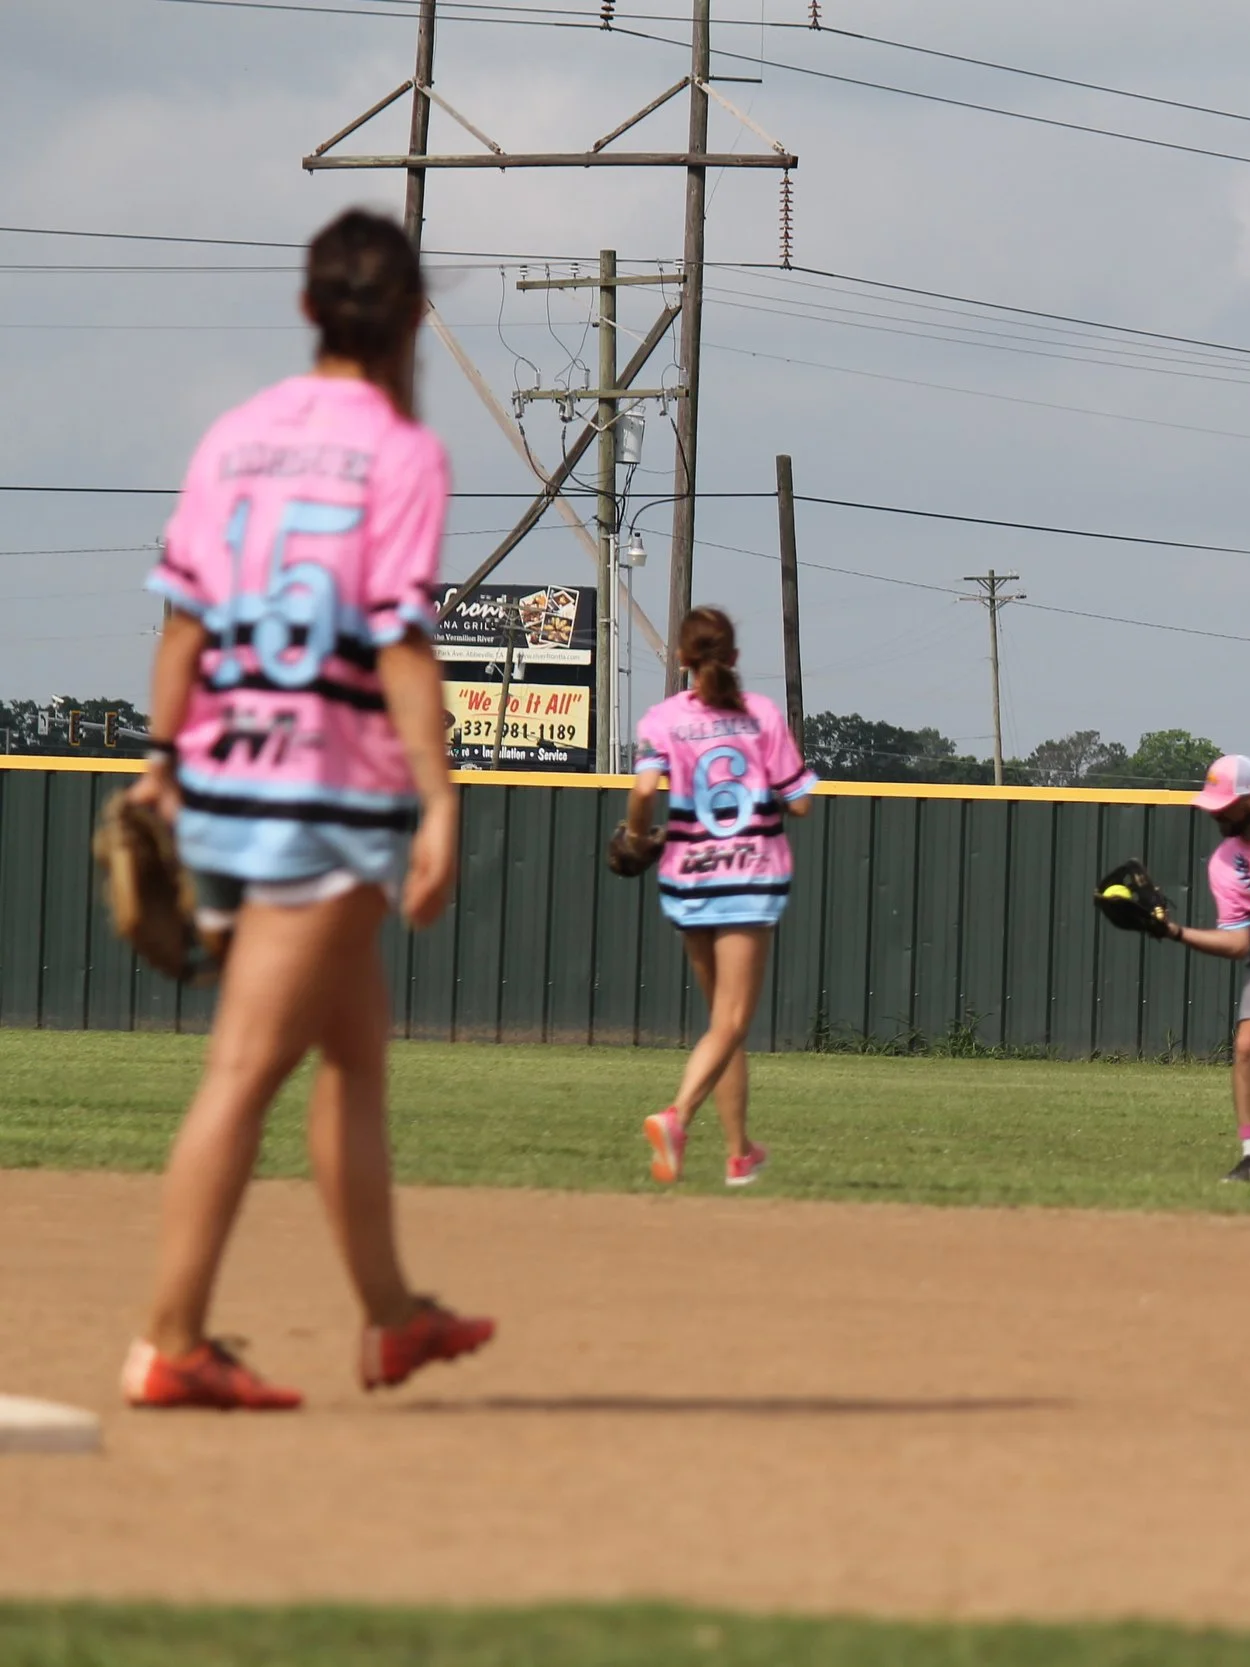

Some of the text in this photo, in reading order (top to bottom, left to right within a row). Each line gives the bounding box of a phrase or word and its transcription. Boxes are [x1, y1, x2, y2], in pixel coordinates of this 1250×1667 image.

[209, 497, 366, 687] 15
[445, 633, 476, 643] Vermilion
[477, 634, 494, 643] River
[526, 692, 542, 714] It
[463, 720, 576, 741] 337-981-1189
[482, 745, 526, 760] Insllation
[538, 747, 568, 761] Service
[693, 745, 754, 838] 6
